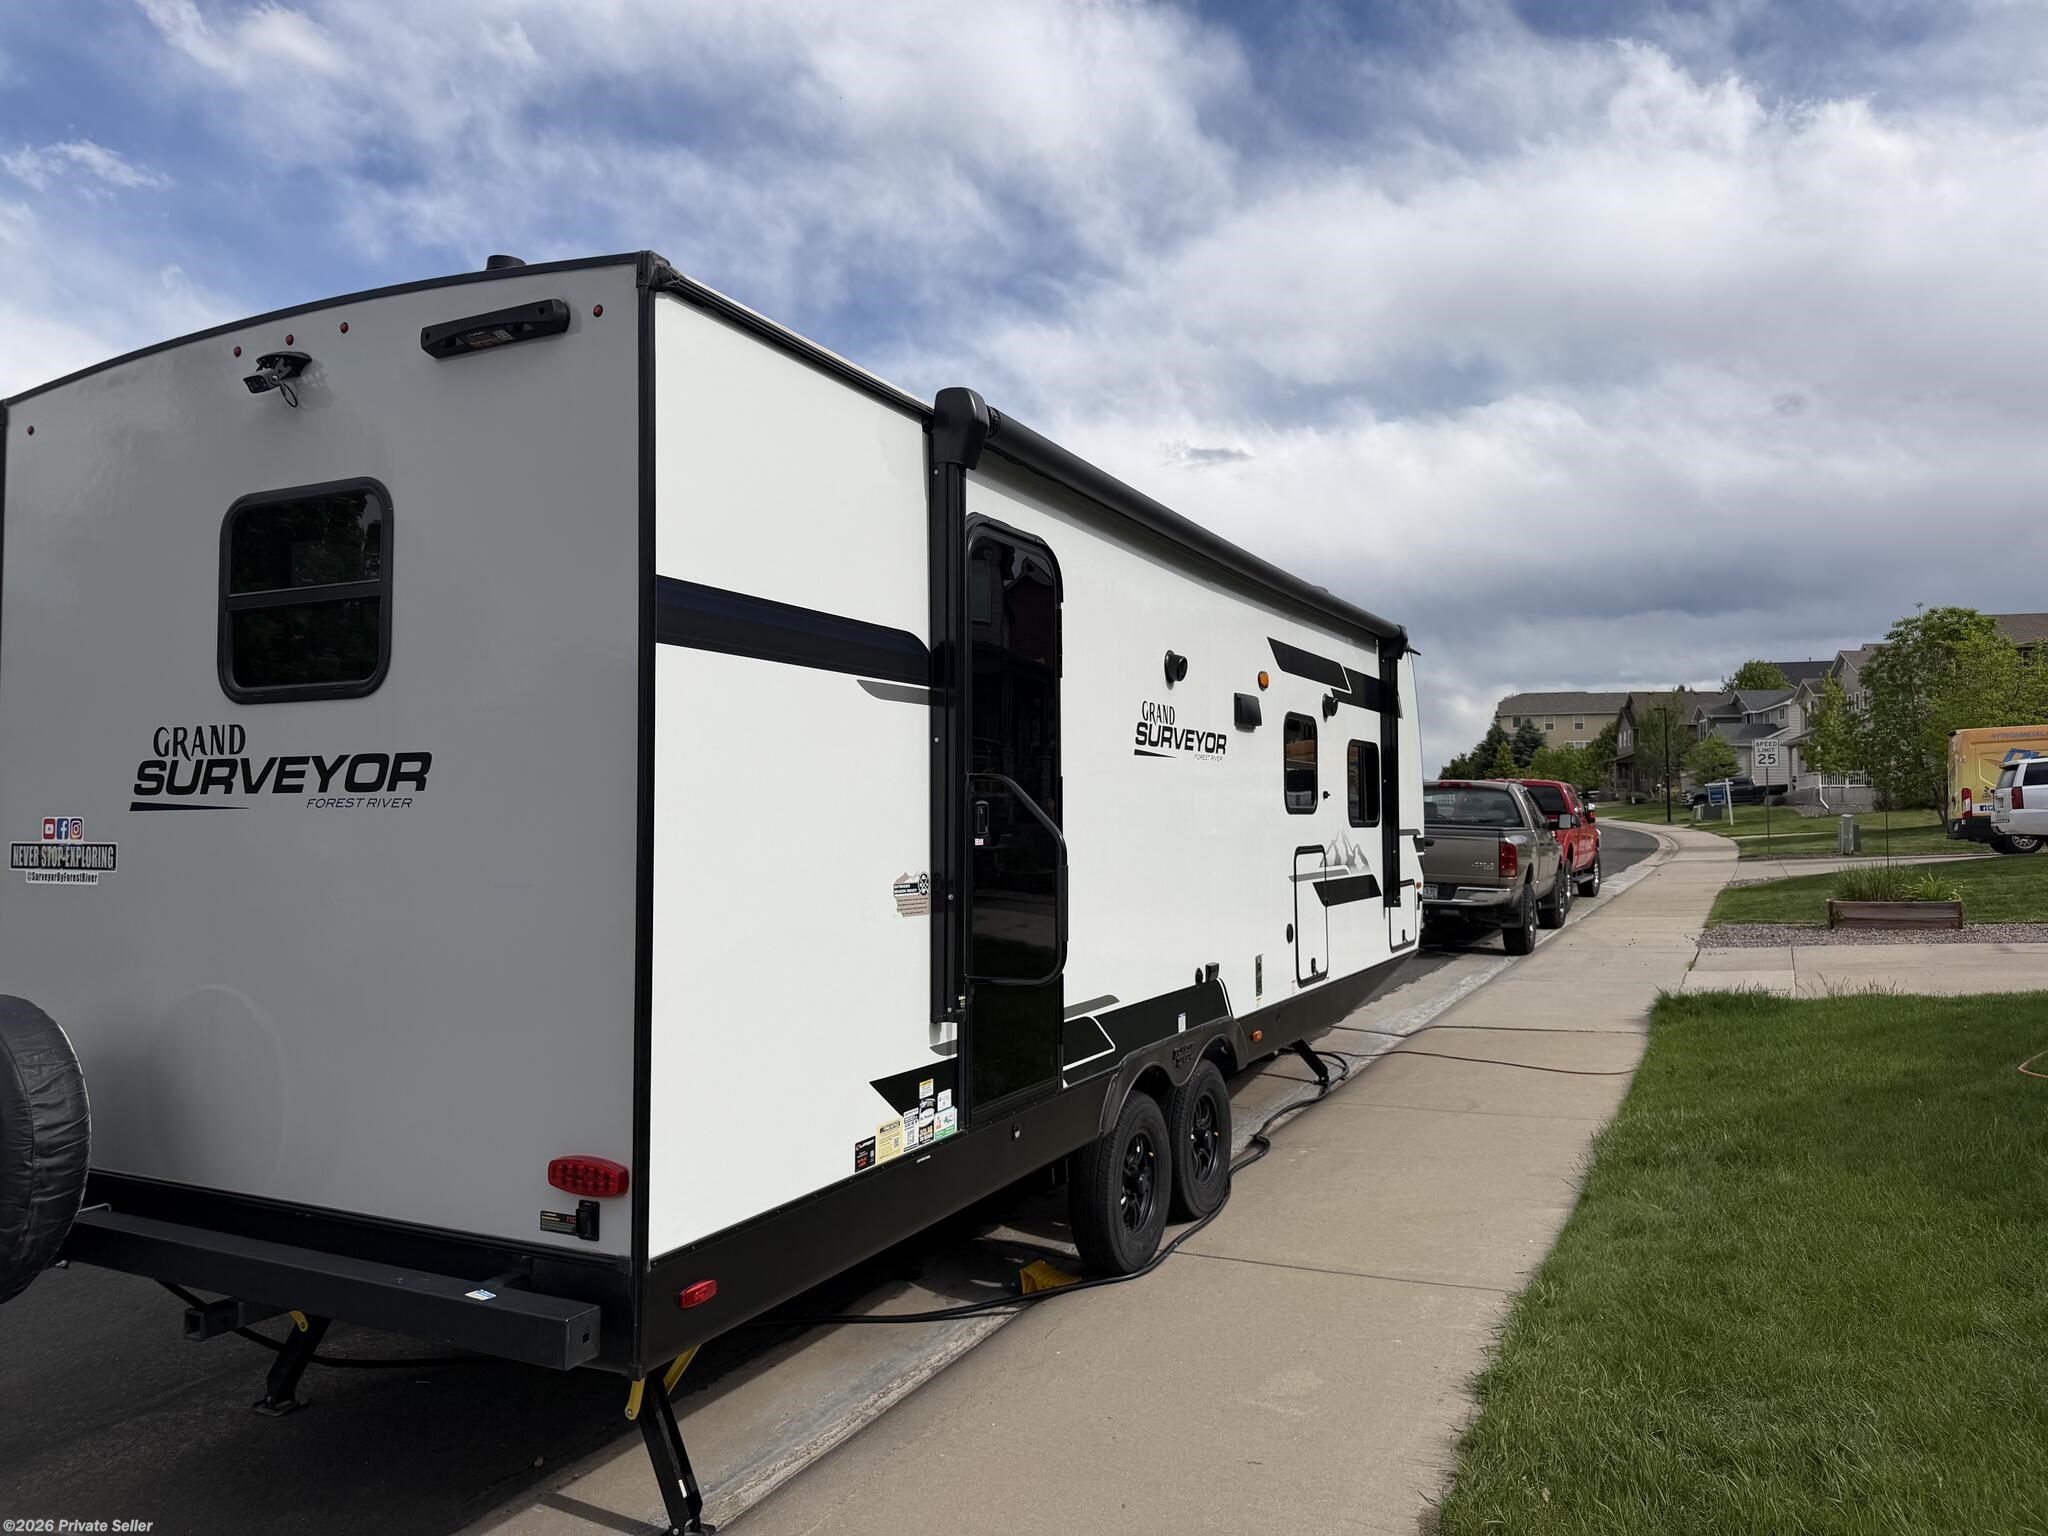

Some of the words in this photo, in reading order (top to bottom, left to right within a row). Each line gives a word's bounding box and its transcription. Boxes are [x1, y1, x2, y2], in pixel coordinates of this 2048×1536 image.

[1142, 700, 1175, 726] GRAND
[153, 724, 246, 761] GRAND
[1135, 721, 1227, 754] SURVEYOR
[1758, 753, 1776, 765] 25
[133, 751, 432, 796] SURVEYOR
[306, 798, 365, 809] FOREST
[366, 797, 413, 809] RIVER
[13, 845, 39, 867] NEVER
[41, 845, 63, 867] STOP
[65, 846, 114, 869] EXPLORING
